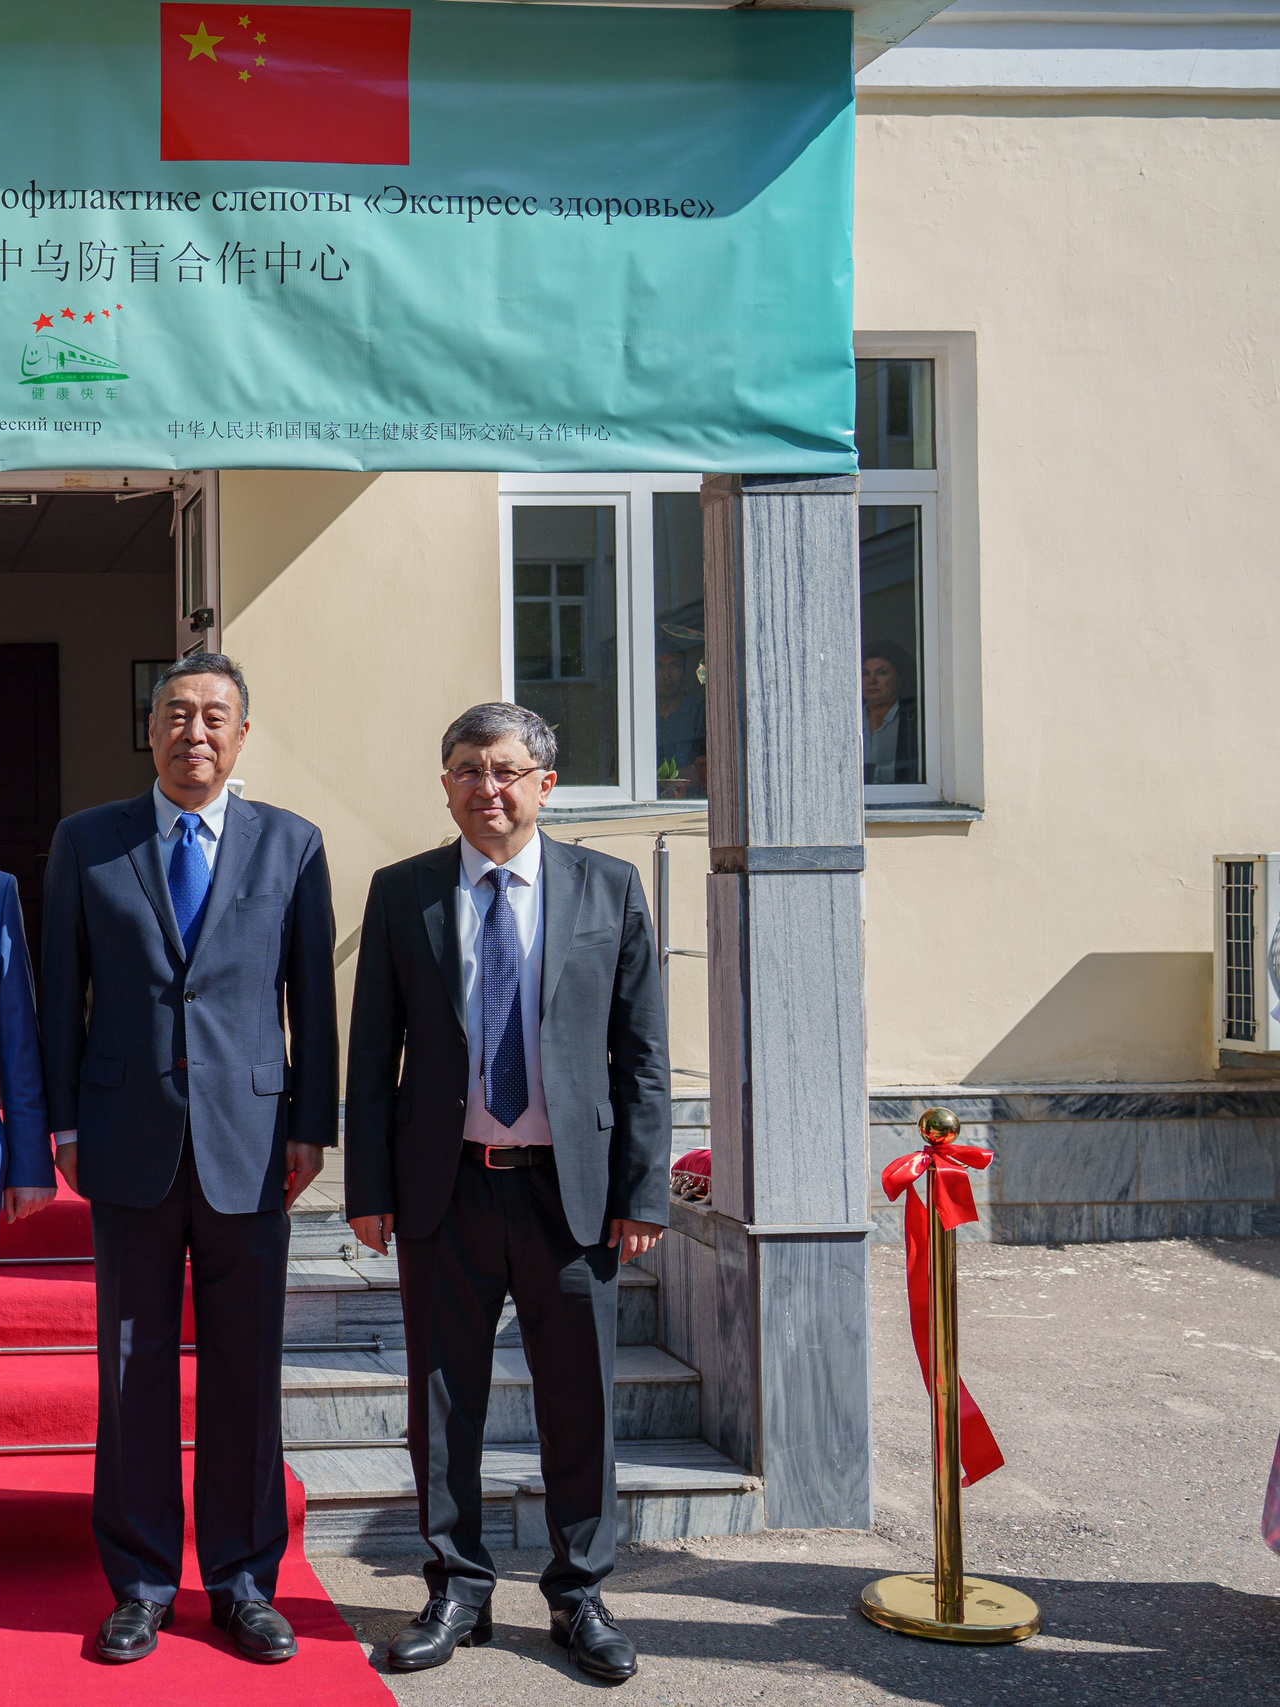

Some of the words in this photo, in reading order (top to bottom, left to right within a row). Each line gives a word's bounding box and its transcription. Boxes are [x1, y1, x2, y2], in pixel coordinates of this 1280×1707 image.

[211, 190, 352, 213] слепоты
[363, 184, 538, 224] «Экспресс
[549, 196, 715, 226] здоровье»
[31, 387, 118, 400] 健康快车
[53, 420, 103, 436] центр
[167, 420, 611, 441] 中华人民共和国国家卫生健康委国际交流与合作中心
